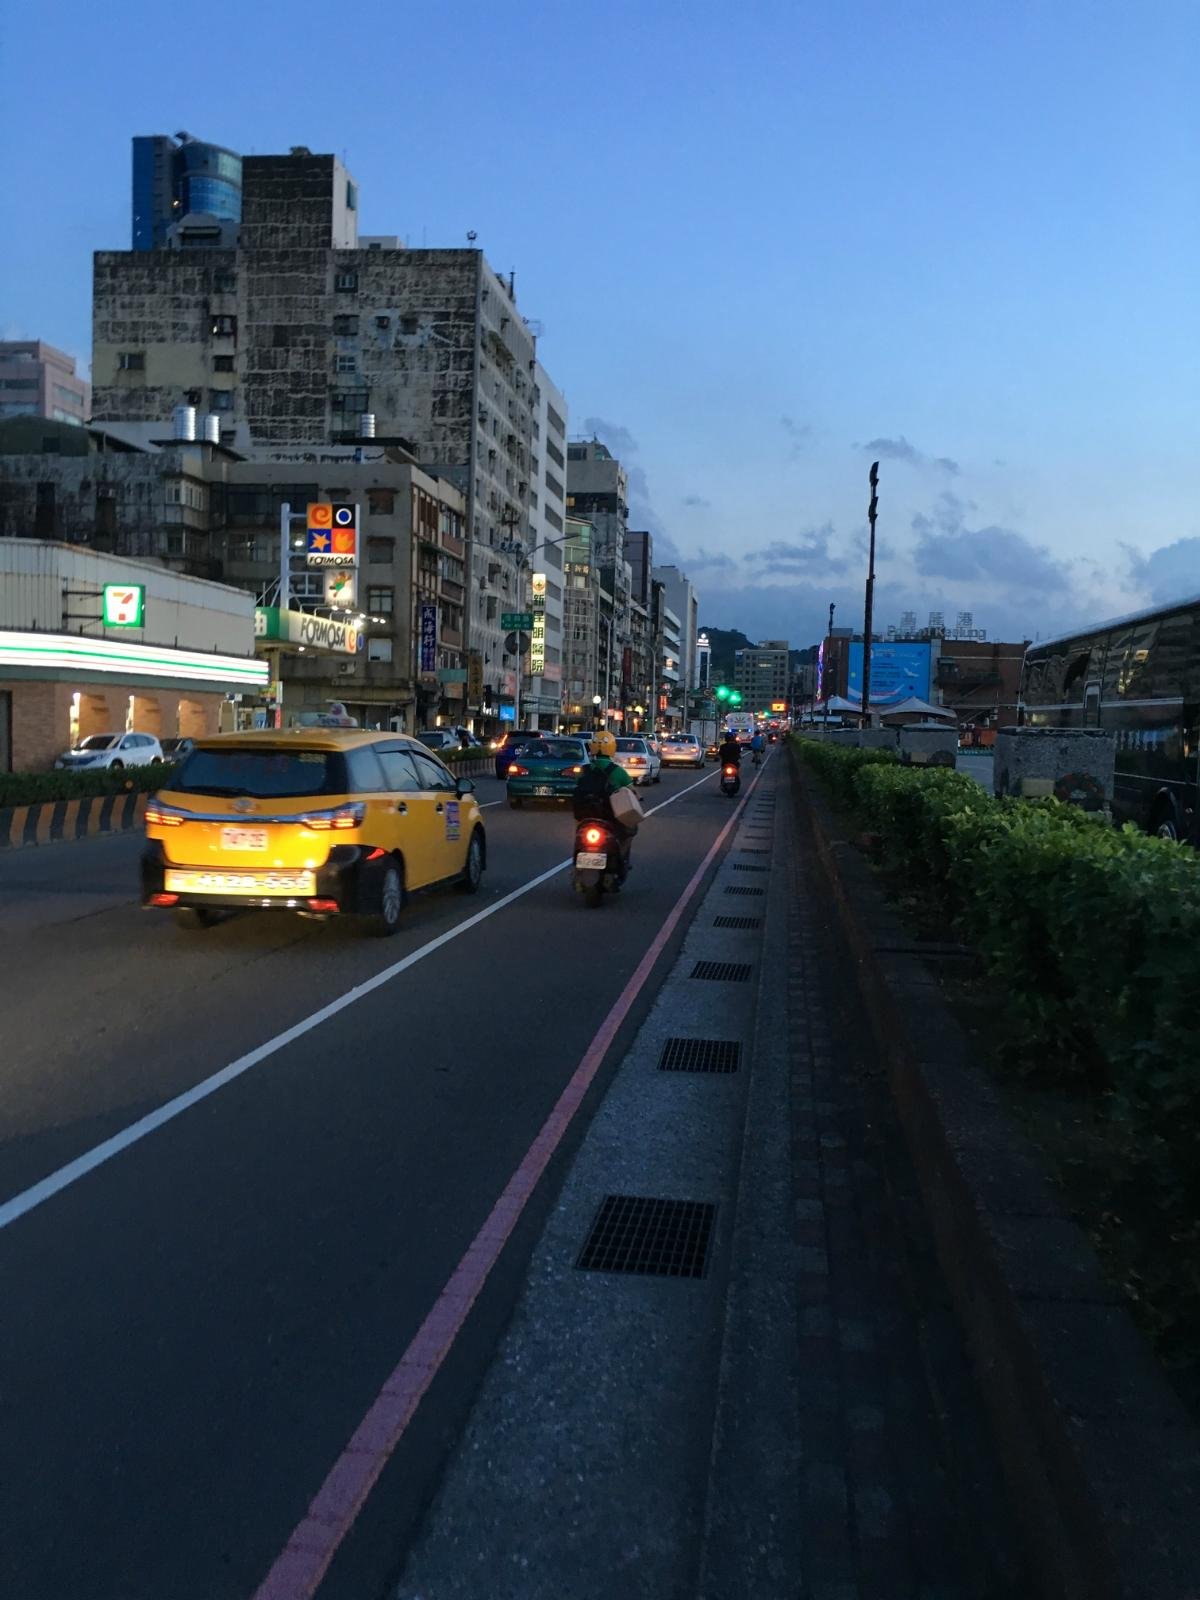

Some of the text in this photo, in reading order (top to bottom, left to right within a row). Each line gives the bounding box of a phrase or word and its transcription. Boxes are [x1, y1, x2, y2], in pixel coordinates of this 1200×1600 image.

[308, 555, 355, 566] FORMOSA
[300, 616, 347, 649] FORMOSA
[934, 626, 987, 641] Keelung
